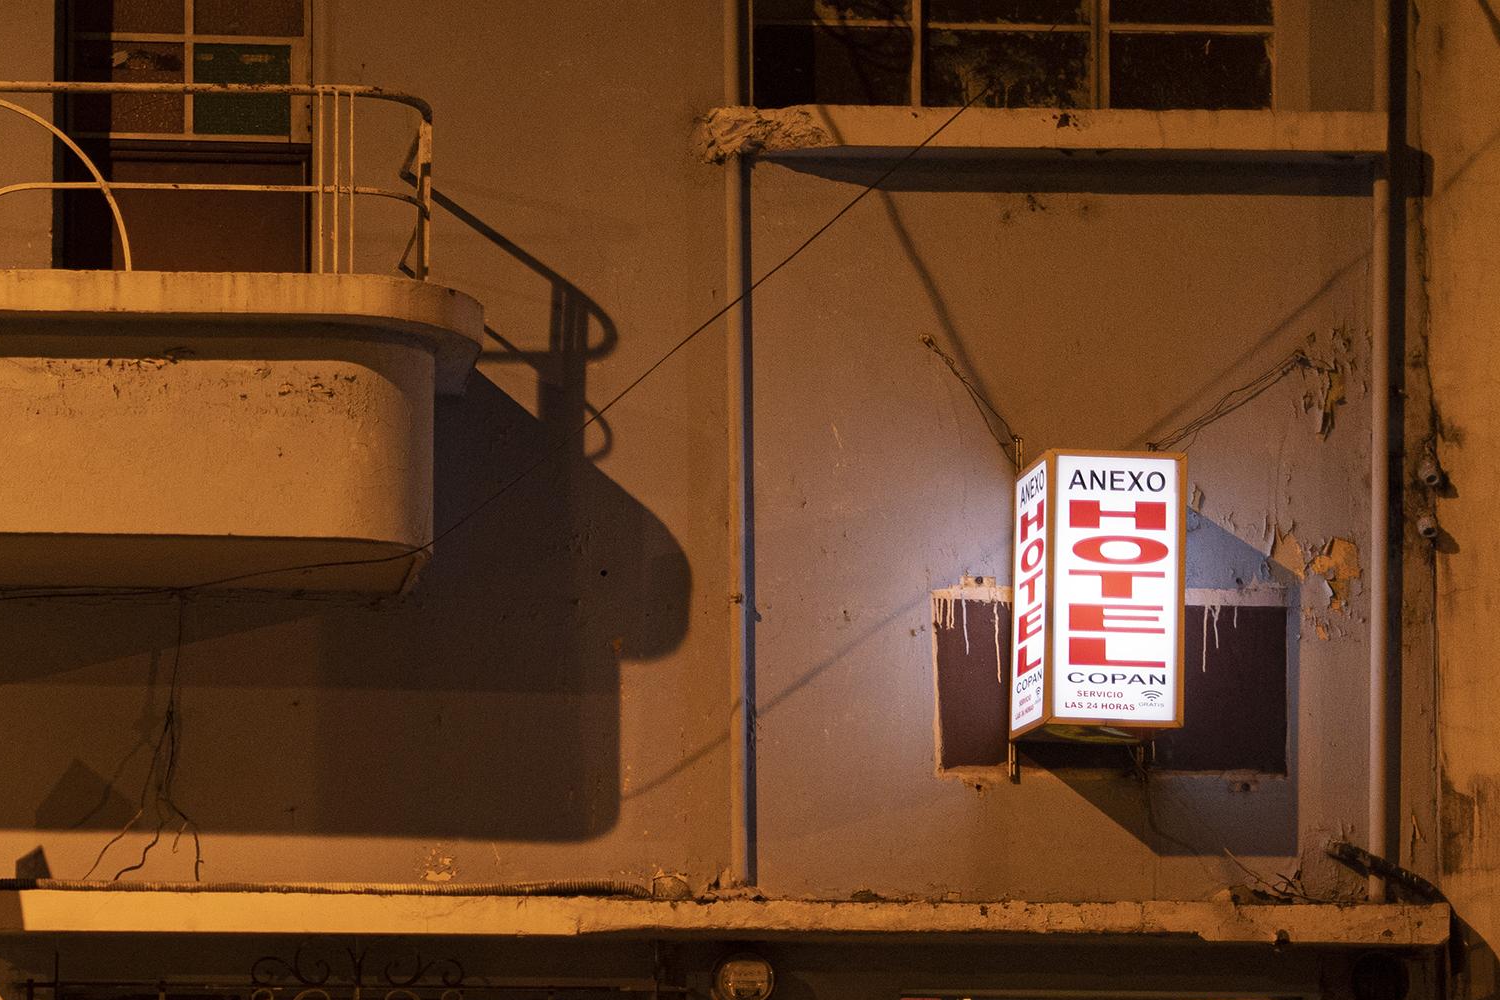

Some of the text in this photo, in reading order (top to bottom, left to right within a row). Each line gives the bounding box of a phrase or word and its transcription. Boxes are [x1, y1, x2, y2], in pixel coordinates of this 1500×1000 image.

[1020, 469, 1045, 508] ANEXO
[1068, 469, 1166, 493] ANEXO
[1017, 498, 1045, 677] HOTEL
[1068, 499, 1169, 668] HOTEL
[1016, 669, 1043, 694] COPAN
[1067, 672, 1166, 685] COPAN
[1064, 701, 1084, 709] LAS
[1101, 702, 1135, 711] HORAS
[1076, 690, 1124, 699] SERVICIO
